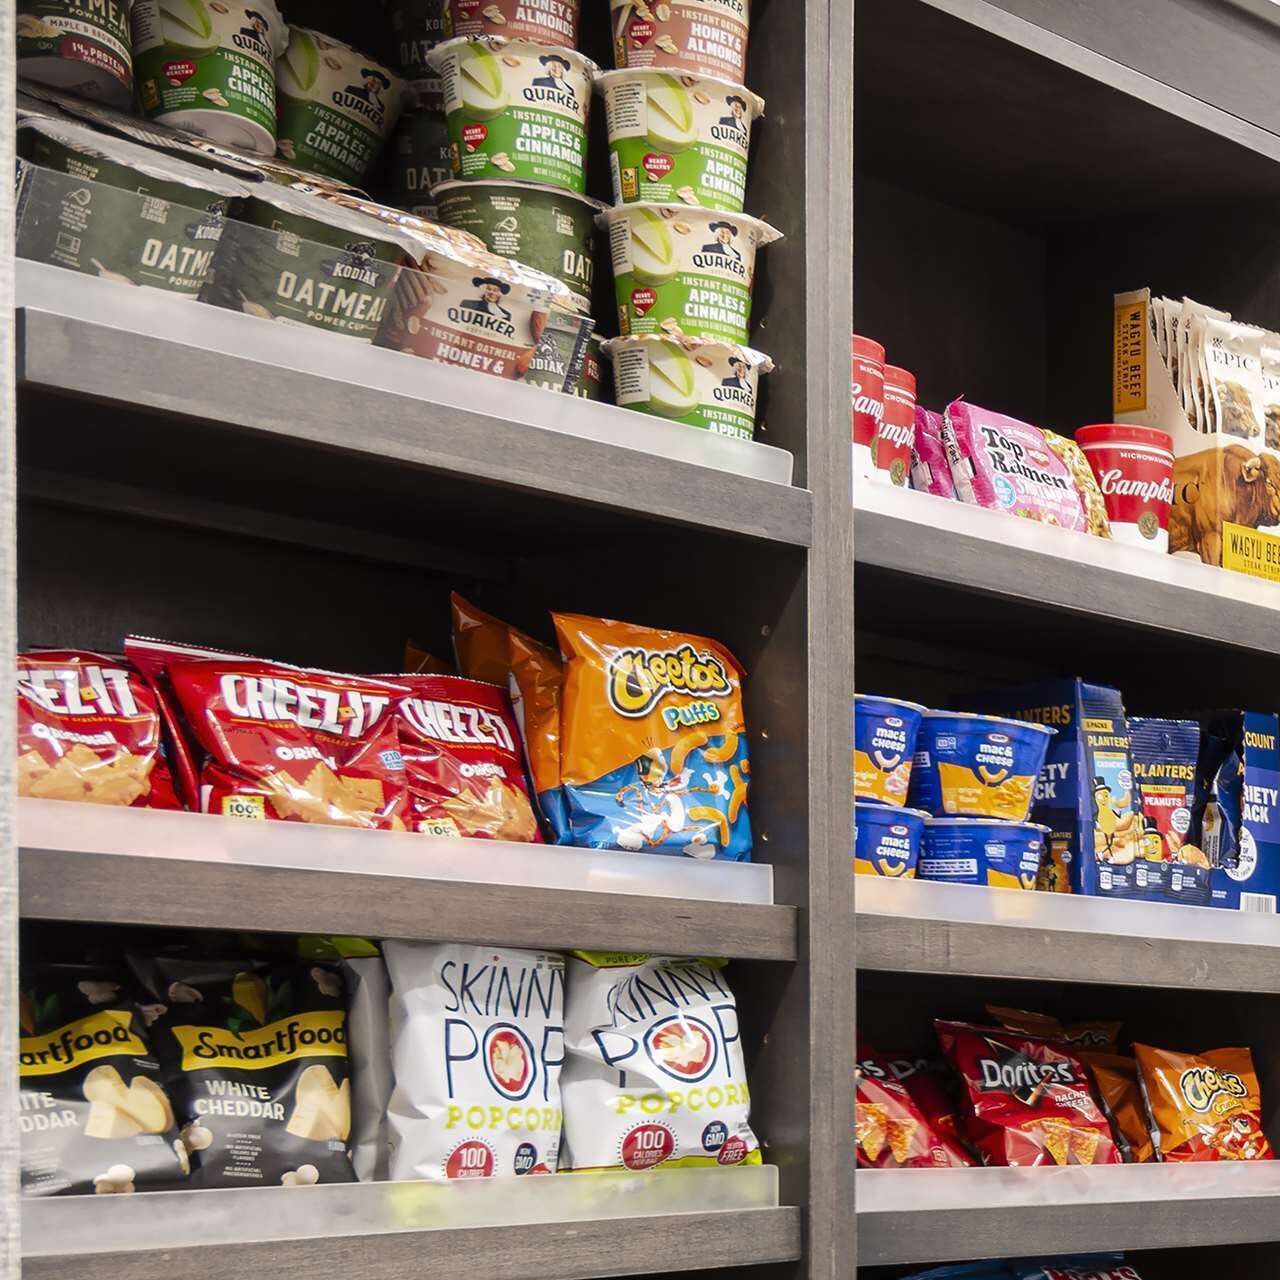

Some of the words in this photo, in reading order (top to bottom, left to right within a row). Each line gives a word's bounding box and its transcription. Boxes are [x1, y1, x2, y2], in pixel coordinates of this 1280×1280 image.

[515, 6, 573, 37] ALMONDS
[690, 24, 734, 47] HONEY
[686, 37, 742, 68] ALMONDS
[332, 91, 384, 128] QUAKER
[522, 87, 580, 114] QUAKER
[519, 122, 571, 148] APPLES
[332, 262, 381, 288] KODIAK
[693, 255, 746, 277] QUAKER
[689, 287, 737, 311] APPLES
[448, 307, 516, 338] QUAKER
[431, 328, 475, 348] INSTANT
[477, 340, 516, 360] OATMEAL
[435, 342, 491, 371] HONEY
[1212, 350, 1254, 371] EPIC
[980, 426, 1023, 459] Top
[990, 450, 1067, 492] Ramen
[1230, 533, 1263, 560] WAGYU
[609, 644, 728, 716] Cheetos
[1087, 735, 1129, 749] PLANTERS
[1134, 763, 1195, 780] PLANTERS
[1144, 795, 1182, 807] PEANUTS
[192, 1022, 346, 1059] Smartfood
[981, 1058, 1075, 1089] Doritos
[205, 1080, 272, 1101] WHITE
[194, 1099, 285, 1123] CHEDDAR
[634, 1130, 666, 1150] 100
[705, 1132, 726, 1146] GMO
[457, 1147, 487, 1167] 100
